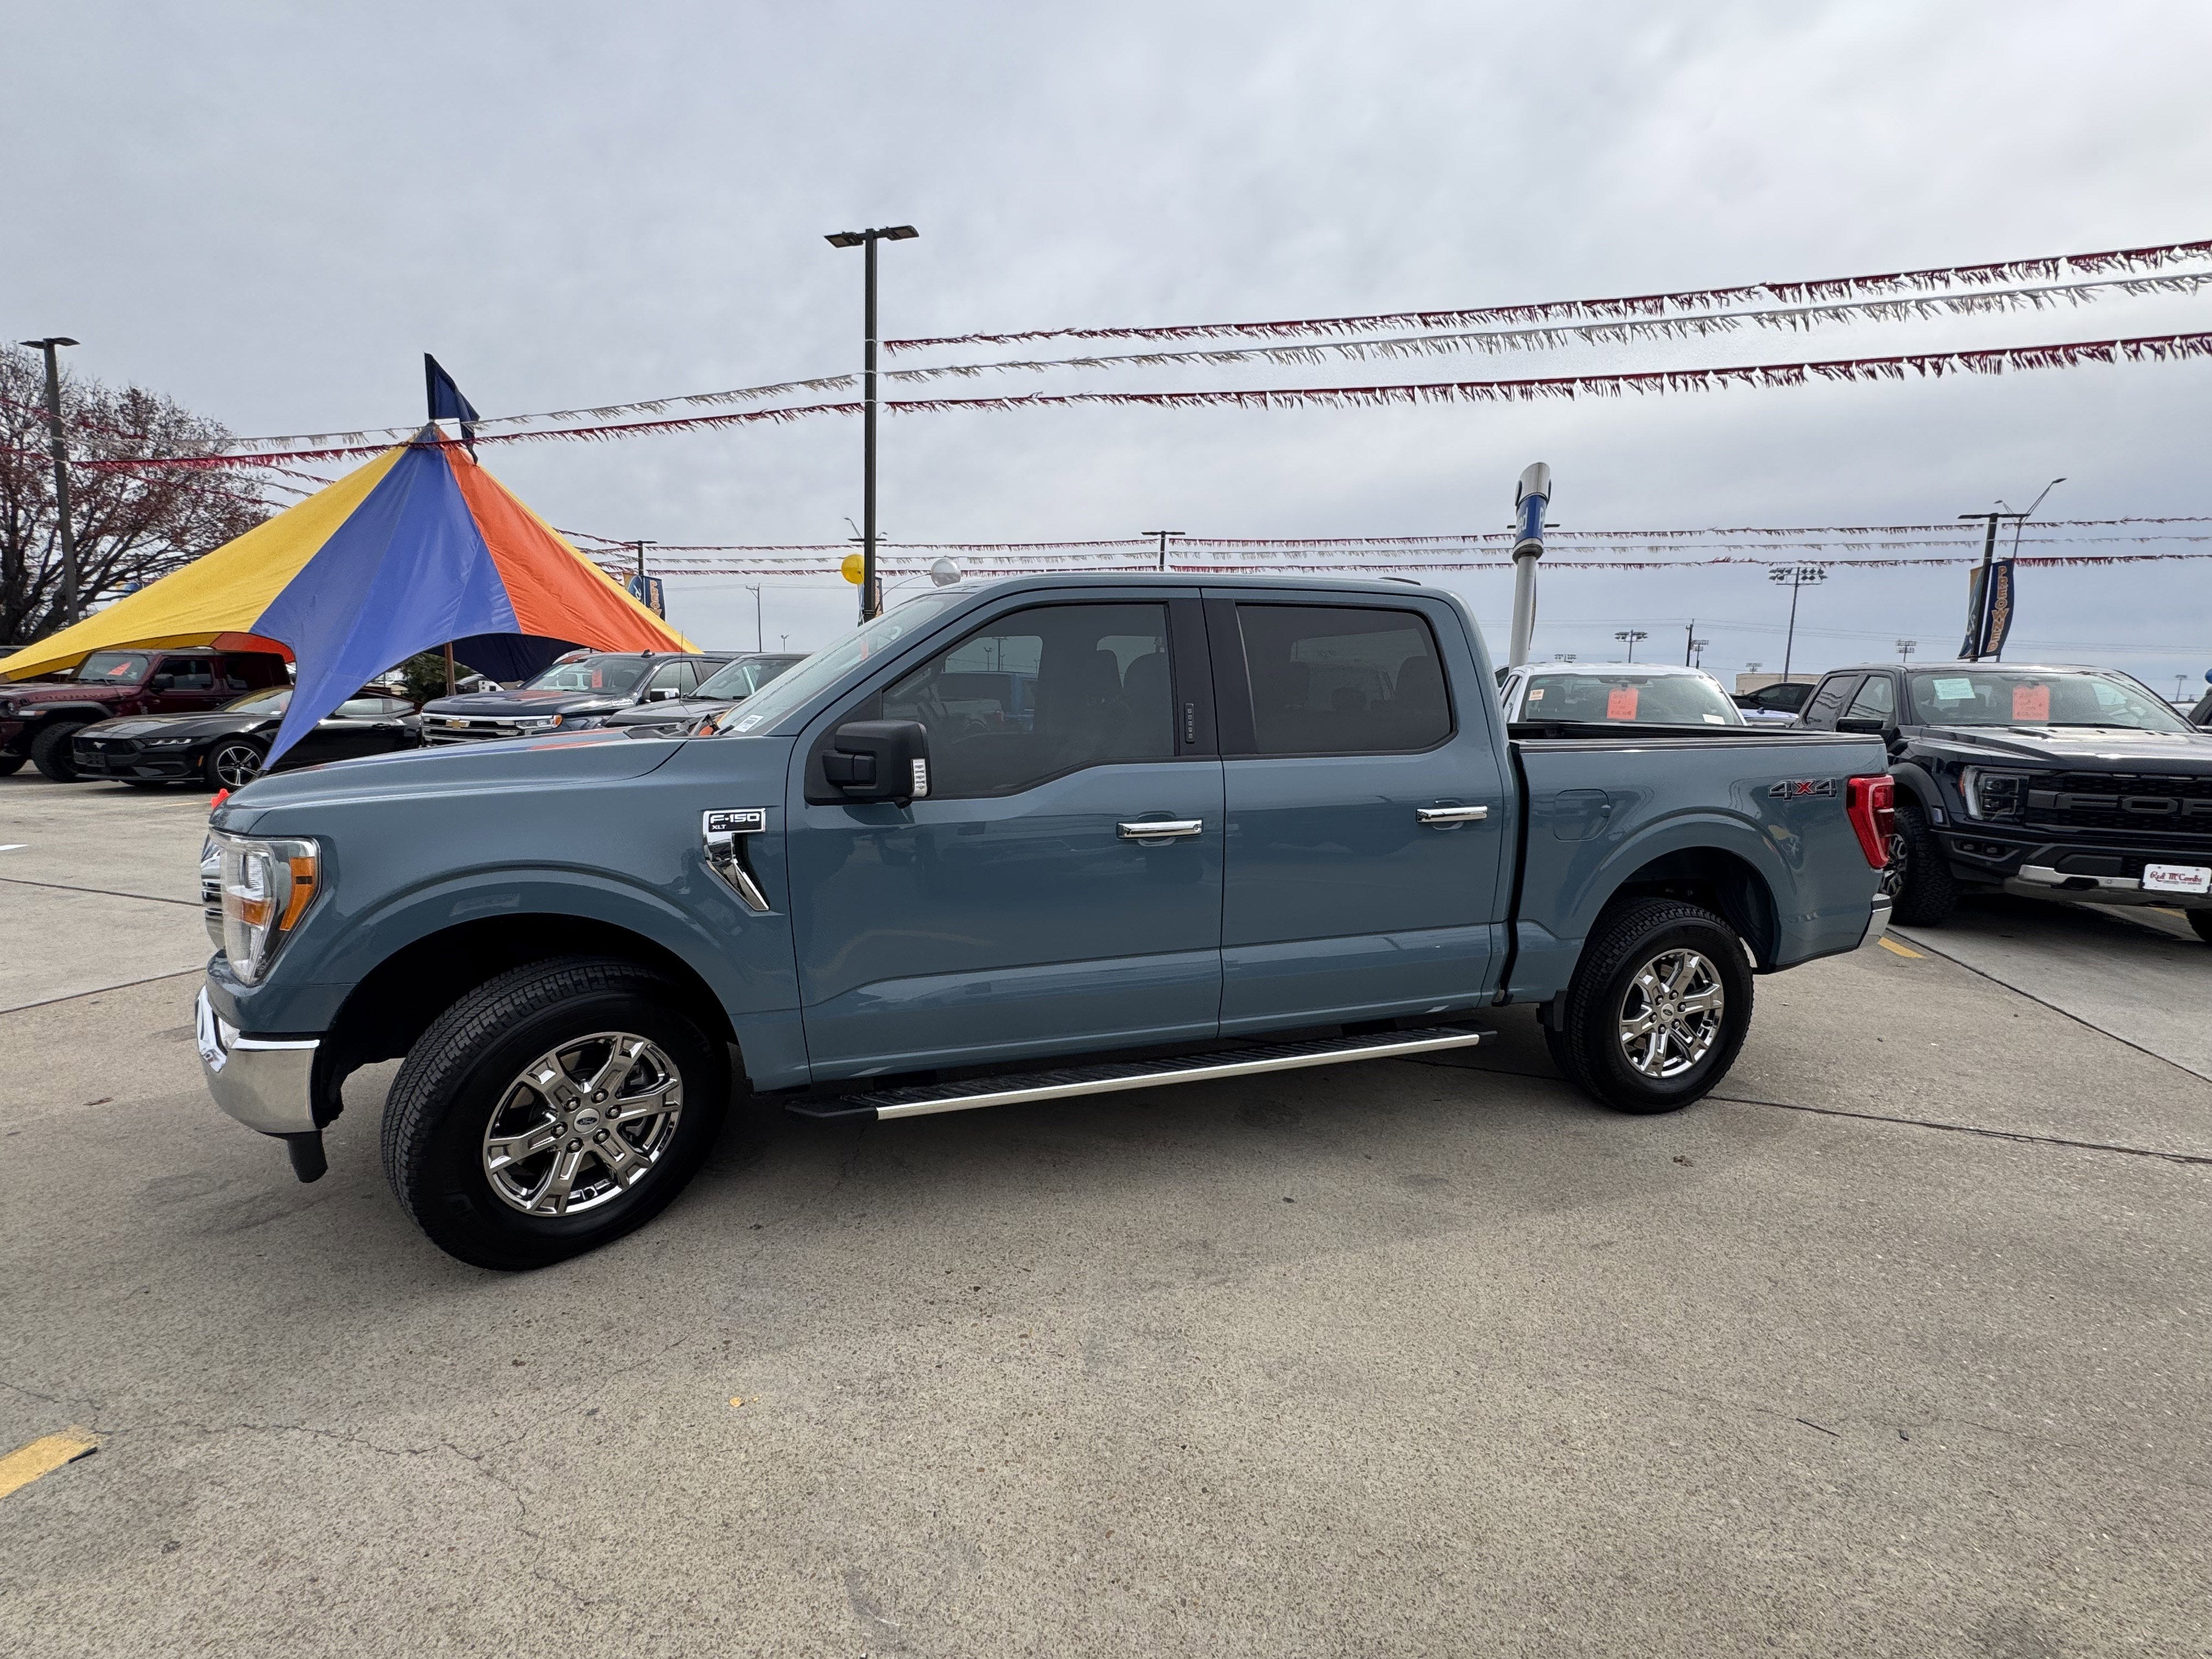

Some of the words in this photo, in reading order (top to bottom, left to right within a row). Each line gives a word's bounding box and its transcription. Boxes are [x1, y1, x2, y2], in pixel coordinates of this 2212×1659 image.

[1985, 566, 2010, 652] PREOWNED
[1768, 778, 1837, 801] 4X4
[710, 813, 760, 824] F-150
[2150, 871, 2166, 882] Red
